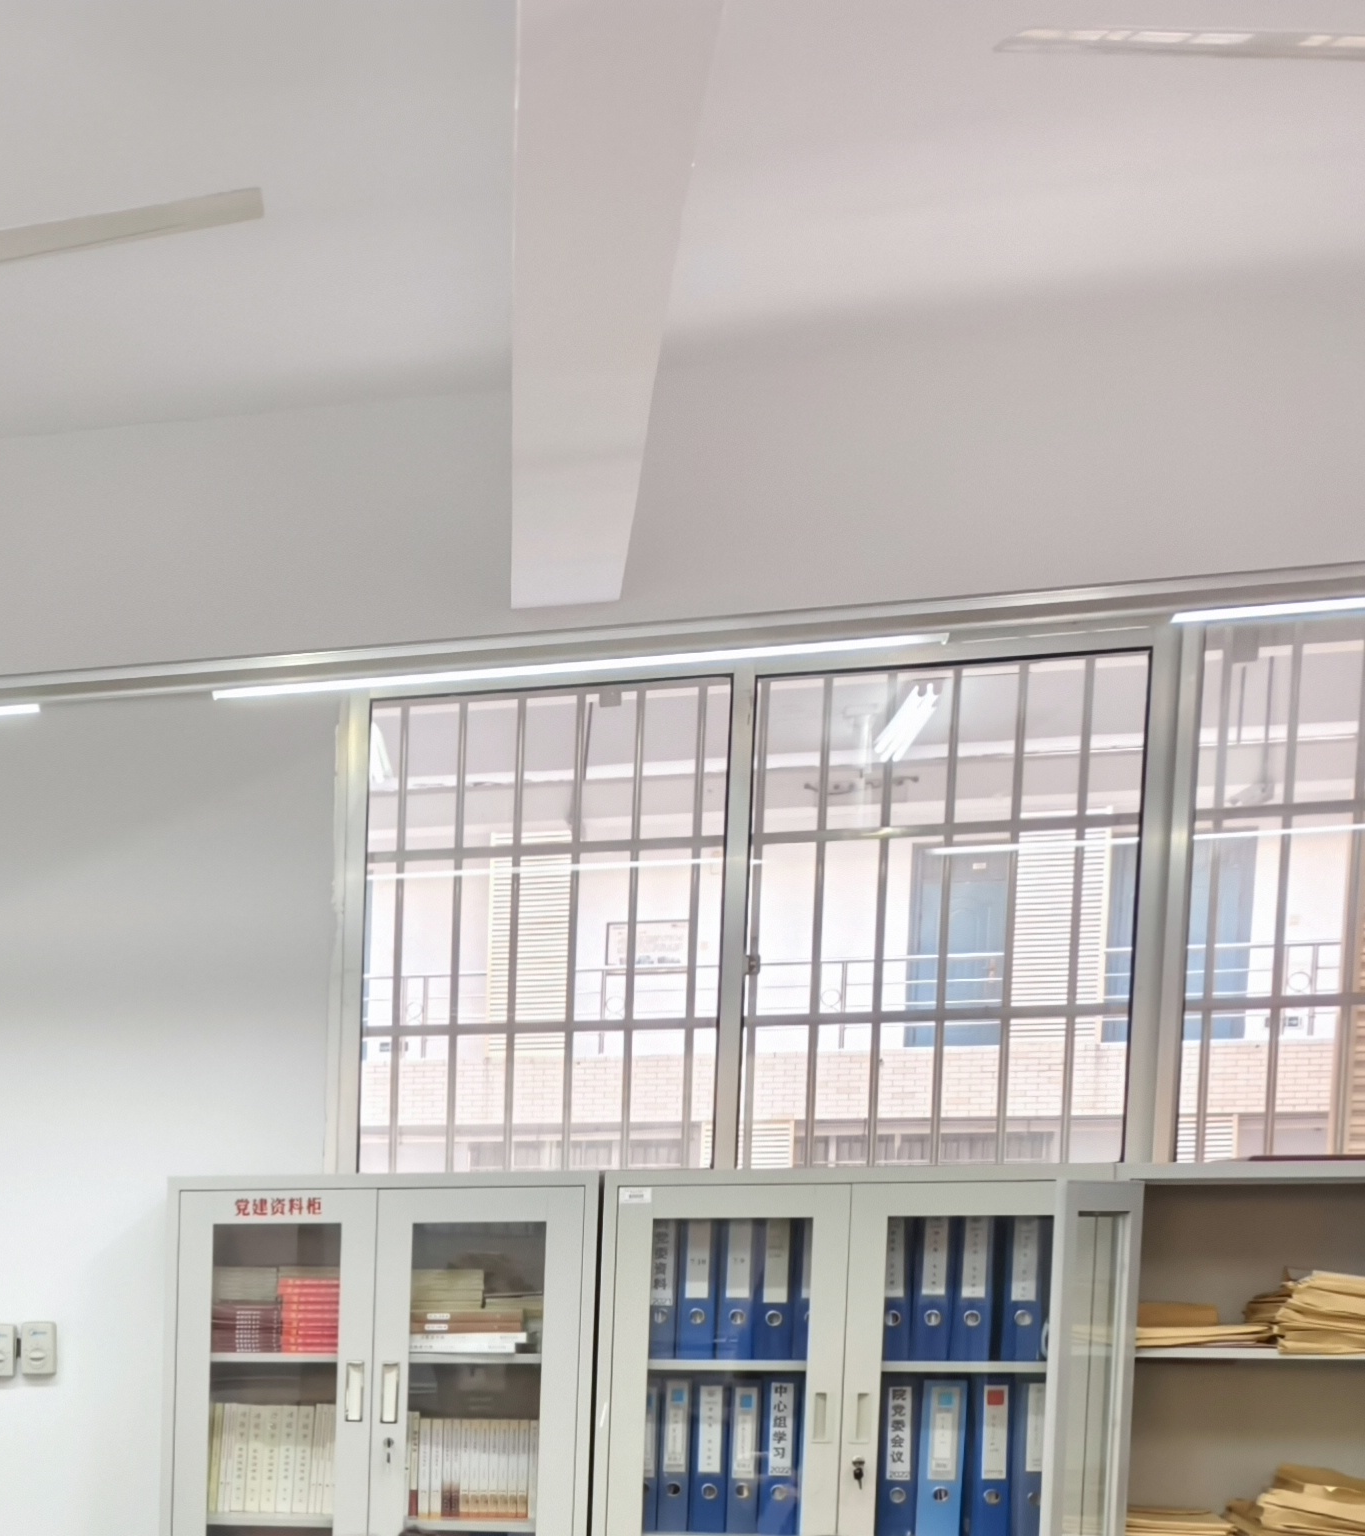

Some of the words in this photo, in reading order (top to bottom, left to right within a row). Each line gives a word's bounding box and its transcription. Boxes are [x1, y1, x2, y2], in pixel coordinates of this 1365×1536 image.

[234, 1197, 322, 1217] 党建资料柜
[772, 1384, 788, 1460] 中心组学习
[890, 1388, 907, 1464] 院党委会议
